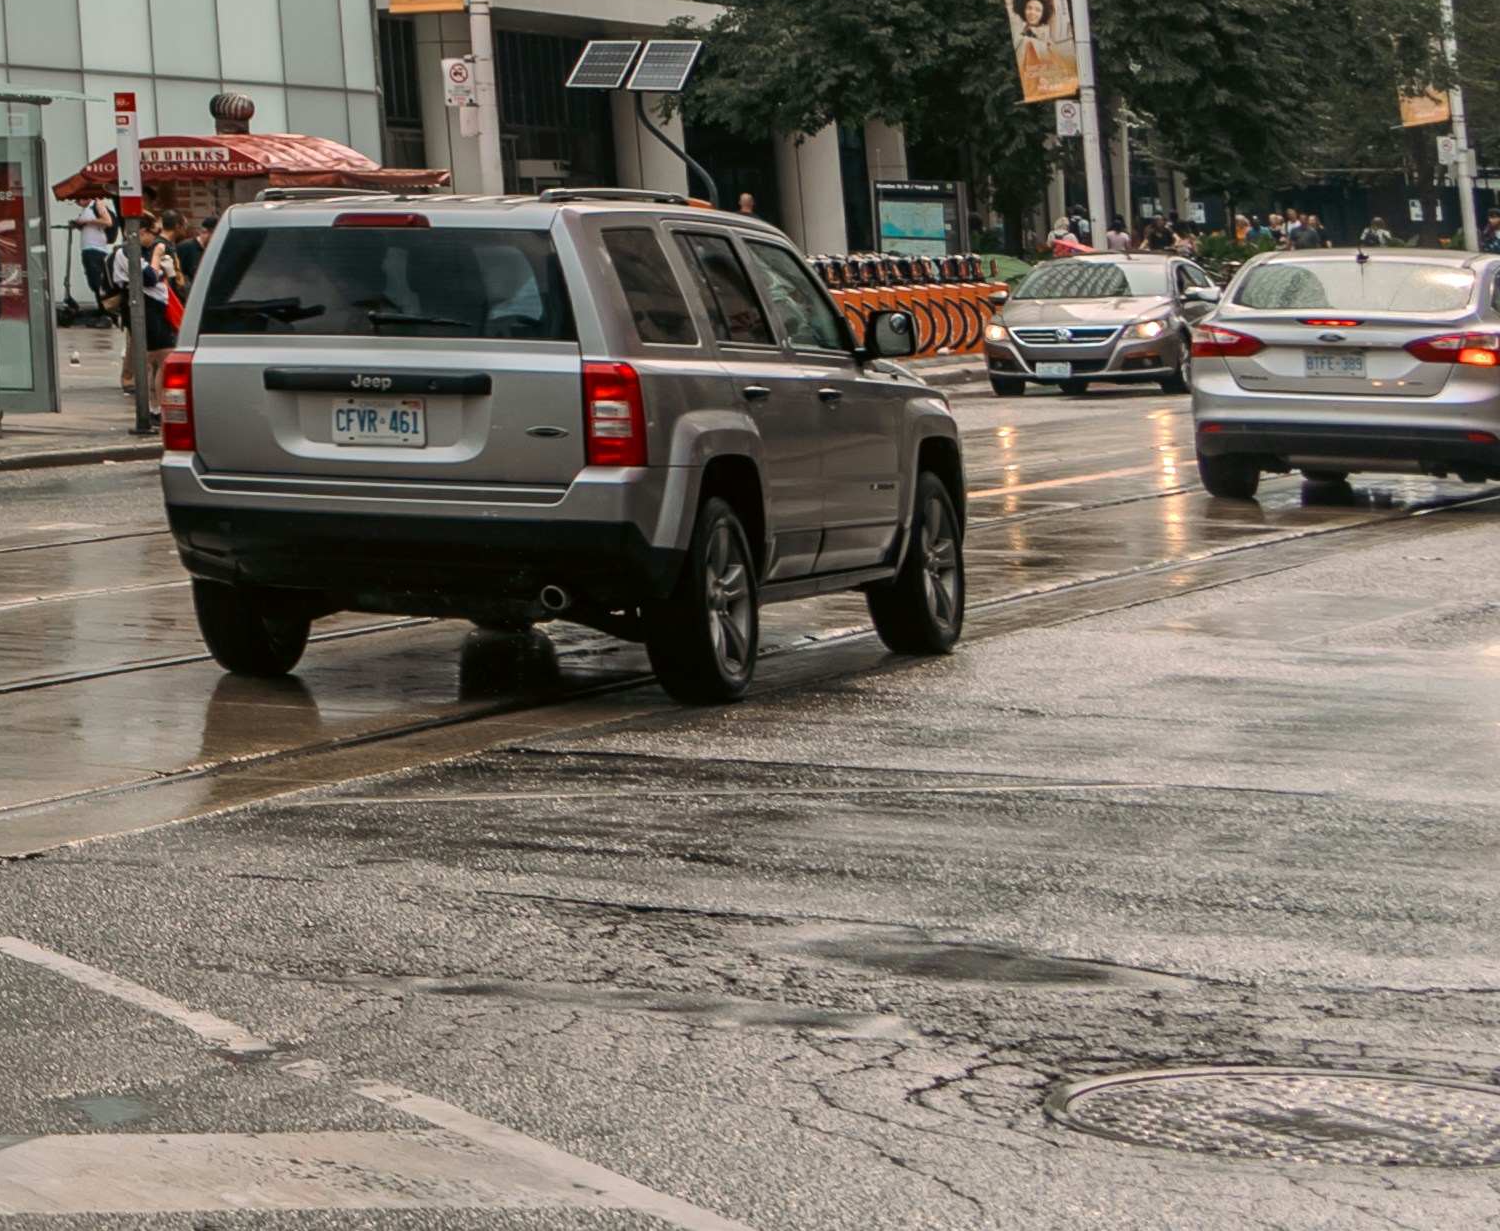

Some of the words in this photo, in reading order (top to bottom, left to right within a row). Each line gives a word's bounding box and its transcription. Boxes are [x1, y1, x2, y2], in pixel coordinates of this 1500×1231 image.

[164, 148, 225, 161] DRINKS
[91, 163, 117, 173] HO
[140, 162, 172, 173] OGS
[179, 161, 256, 173] SAUSAGES
[350, 373, 392, 391] Jeep
[335, 408, 378, 433] CFVR
[388, 409, 420, 435] 461
